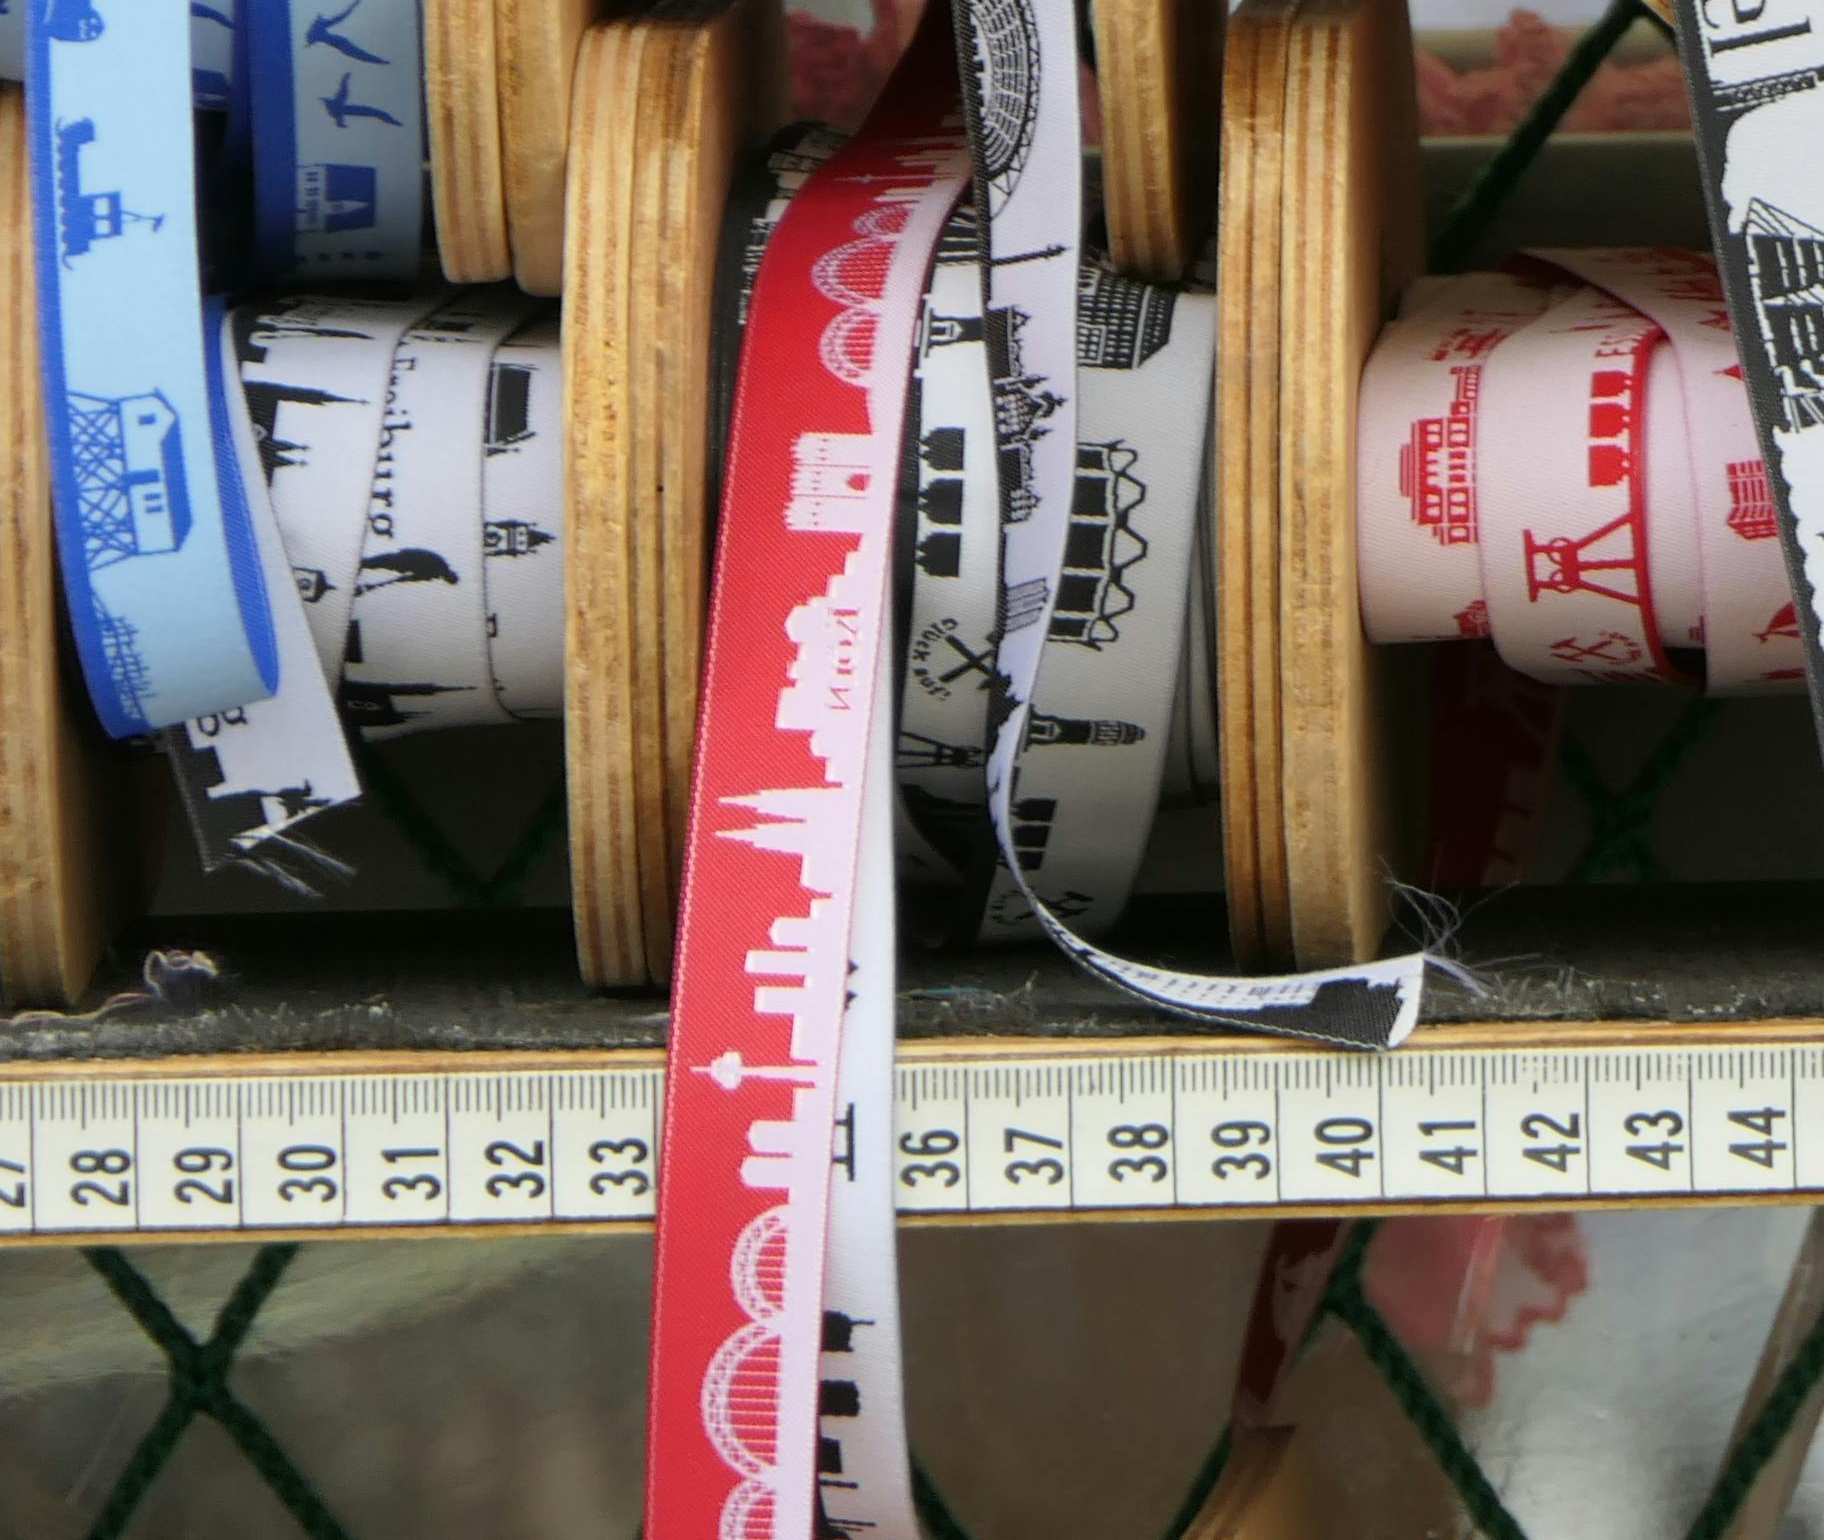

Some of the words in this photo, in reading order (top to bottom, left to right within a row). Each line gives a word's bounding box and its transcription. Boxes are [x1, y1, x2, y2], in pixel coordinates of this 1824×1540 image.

[901, 1132, 959, 1185] 36
[1007, 1130, 1062, 1182] 37
[1110, 1126, 1168, 1180] 38
[1214, 1123, 1269, 1177] 39
[1317, 1120, 1372, 1176] 40
[1421, 1123, 1476, 1173] 41
[1523, 1115, 1578, 1170] 42
[1626, 1112, 1682, 1168] 43
[1730, 1109, 1785, 1167] 44
[72, 1152, 130, 1205] 28
[175, 1151, 232, 1203] 29
[279, 1148, 336, 1200] 30
[384, 1151, 440, 1198] 31
[486, 1143, 544, 1196] 32
[590, 1140, 647, 1194] 33
